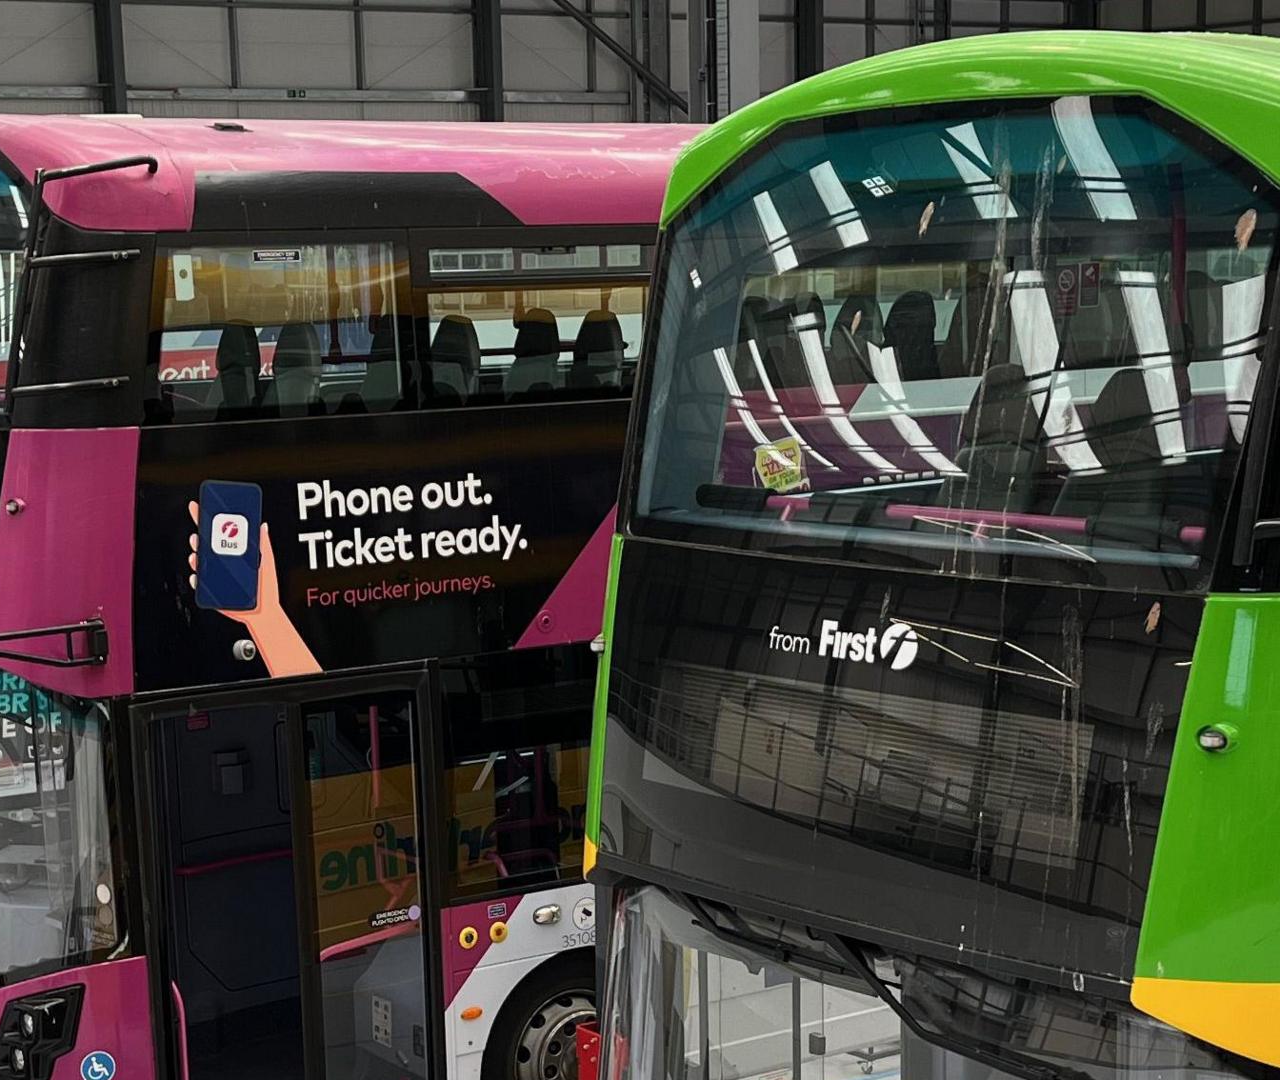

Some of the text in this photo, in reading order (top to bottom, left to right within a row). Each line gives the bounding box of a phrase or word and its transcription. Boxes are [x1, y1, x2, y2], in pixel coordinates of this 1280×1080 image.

[297, 472, 493, 520] Phone out.
[220, 539, 239, 550] Bus
[298, 515, 528, 570] Ticket ready.
[307, 575, 496, 608] For quicker journeys.
[769, 619, 878, 663] from First
